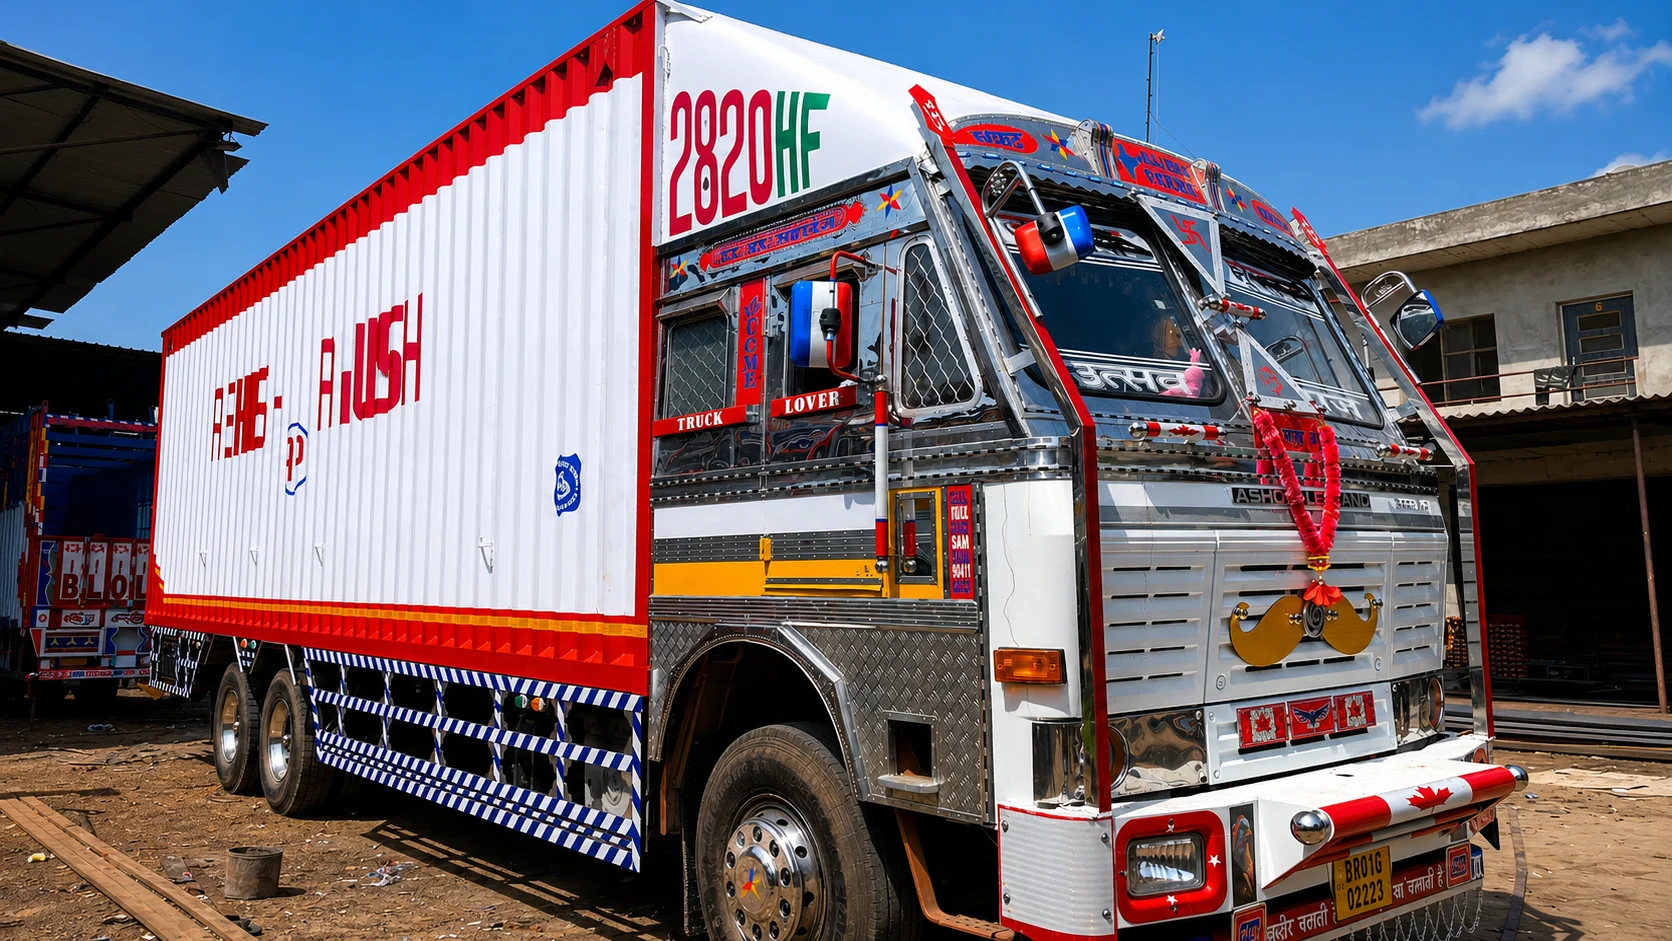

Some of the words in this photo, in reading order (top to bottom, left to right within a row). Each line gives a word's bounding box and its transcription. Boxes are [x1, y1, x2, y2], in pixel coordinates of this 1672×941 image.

[669, 89, 831, 237] 2820HF
[1595, 302, 1602, 311] 6
[785, 390, 839, 414] LOVER
[677, 411, 723, 431] TRUCK
[1236, 488, 1287, 505] ASHO
[1305, 491, 1370, 508] LEAND
[951, 534, 970, 550] SAM
[1346, 879, 1385, 911] 02223
